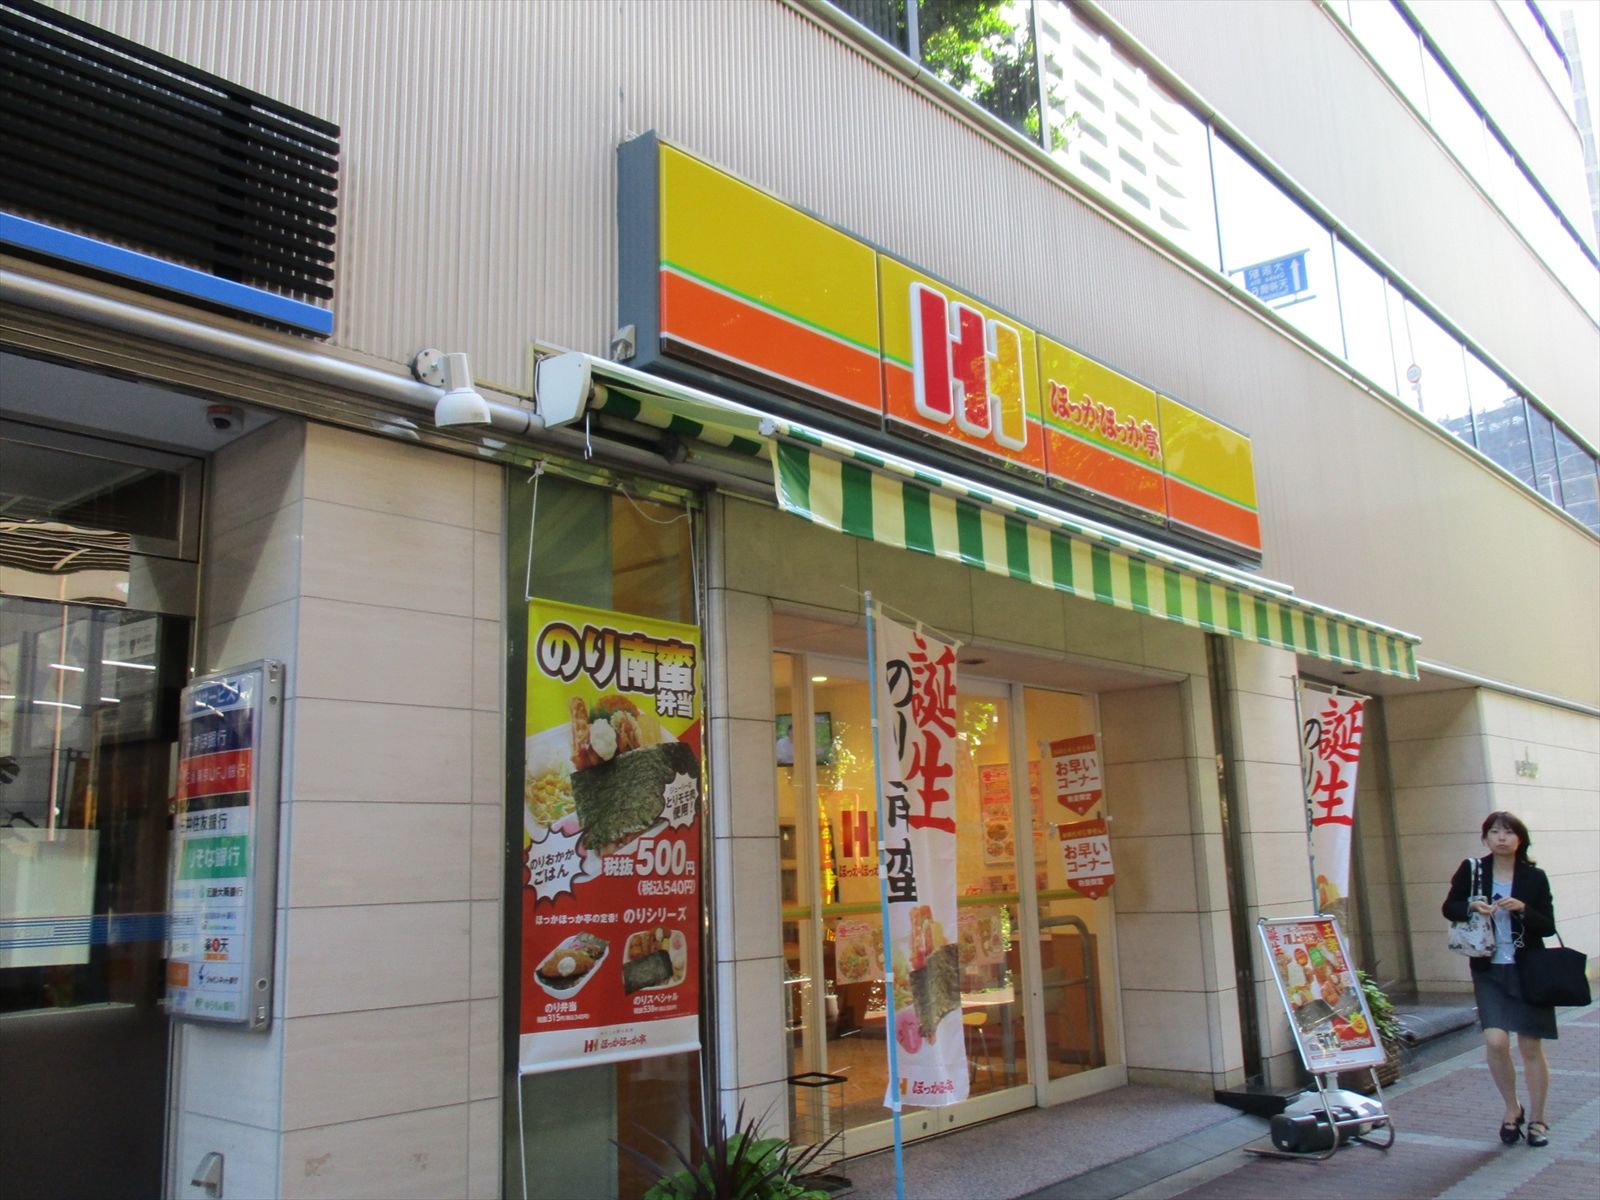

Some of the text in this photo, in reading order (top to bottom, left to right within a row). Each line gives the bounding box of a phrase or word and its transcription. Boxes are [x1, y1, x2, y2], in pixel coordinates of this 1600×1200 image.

[1047, 378, 1163, 462] ほっかほっか亭
[537, 622, 696, 693] のり南蛮
[655, 691, 694, 720] 弁当
[907, 631, 957, 834] 誕生
[1056, 758, 1097, 777] お早い
[1311, 697, 1364, 828] 誕生
[1057, 774, 1099, 789] コーナー
[189, 846, 241, 869] りそな銀行
[1064, 842, 1108, 860] お早い
[534, 864, 569, 885] ごはん
[1067, 858, 1111, 873] コーナー
[623, 905, 688, 924] のりシリーズ
[544, 1001, 578, 1014] のり弁当
